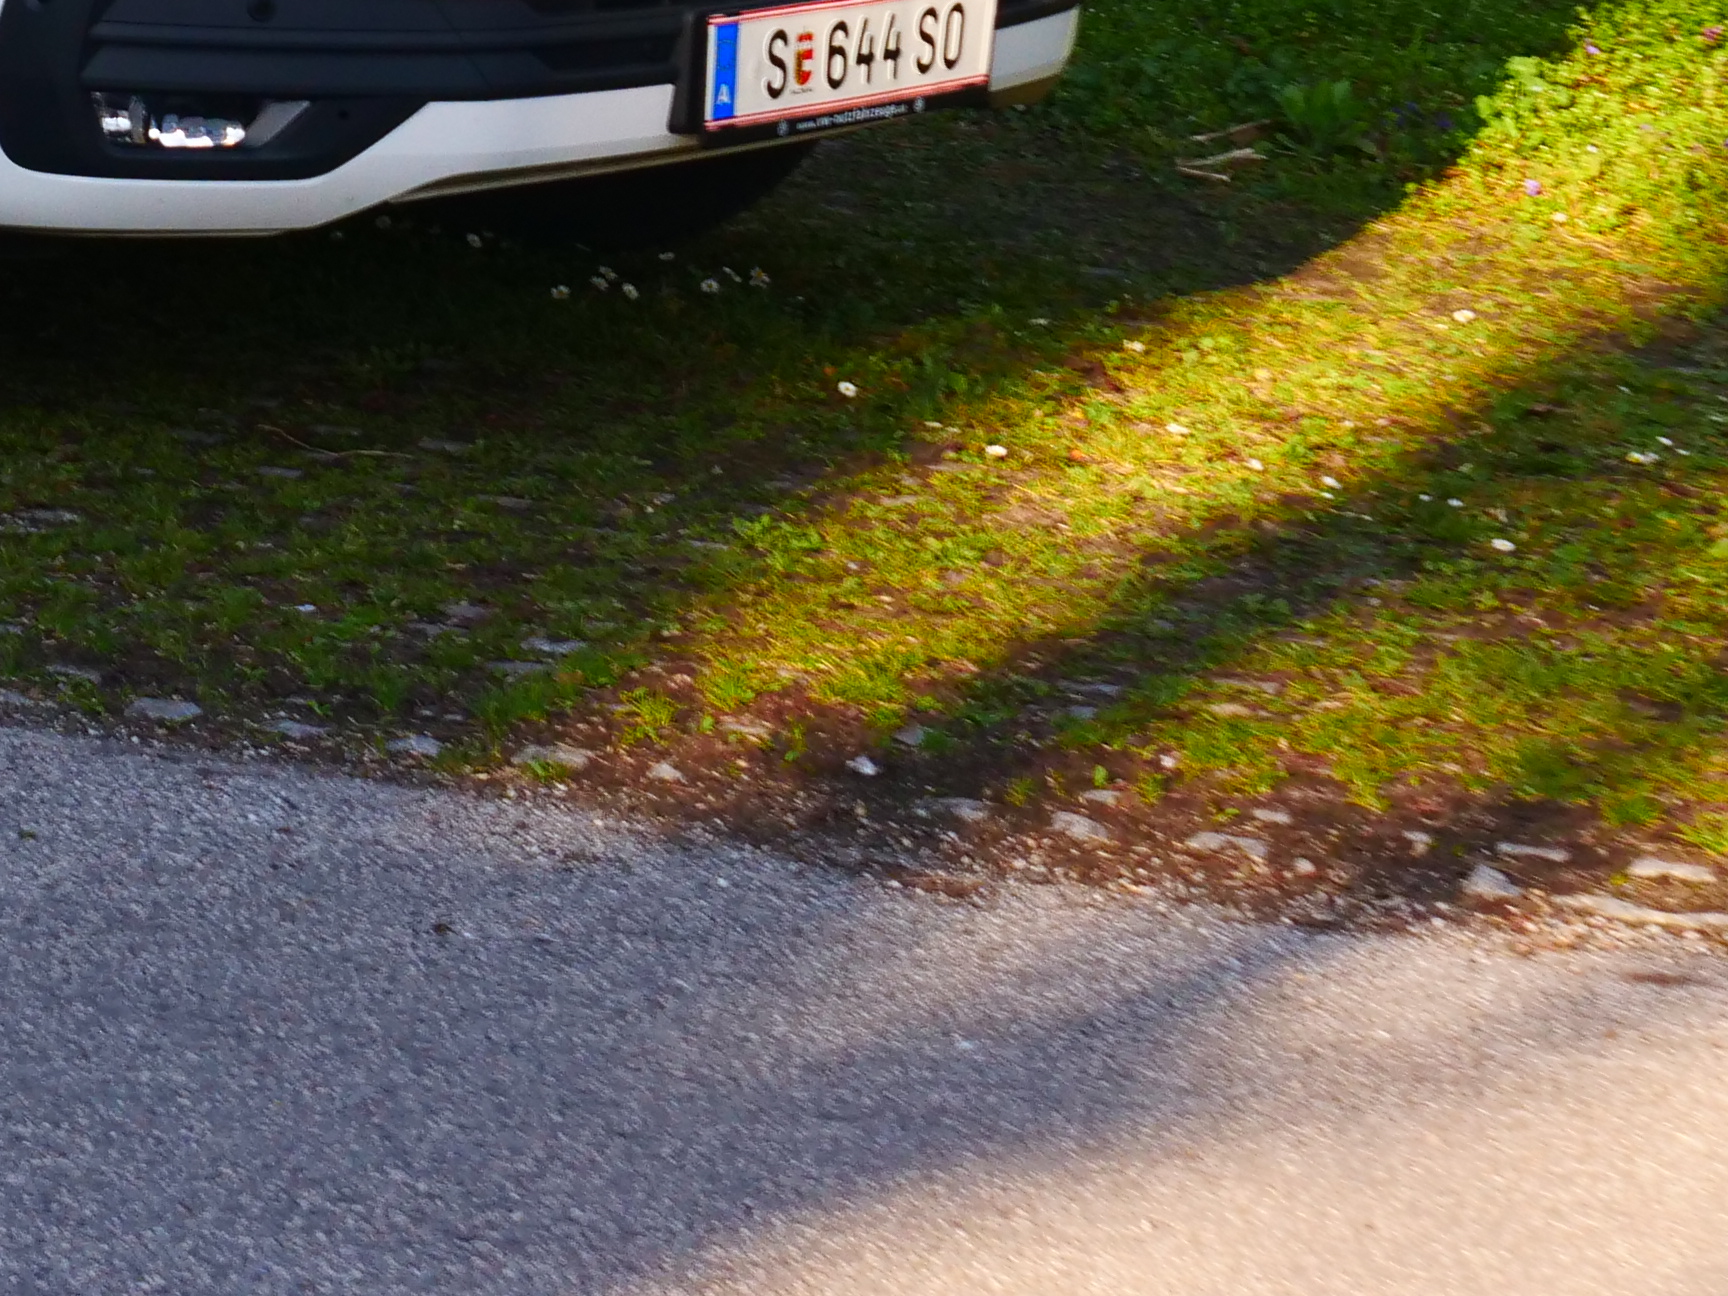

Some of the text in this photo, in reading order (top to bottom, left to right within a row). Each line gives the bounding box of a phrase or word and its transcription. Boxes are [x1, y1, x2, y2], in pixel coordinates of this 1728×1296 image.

[764, 27, 788, 100] S
[823, 10, 902, 90] 644
[716, 83, 732, 105] A
